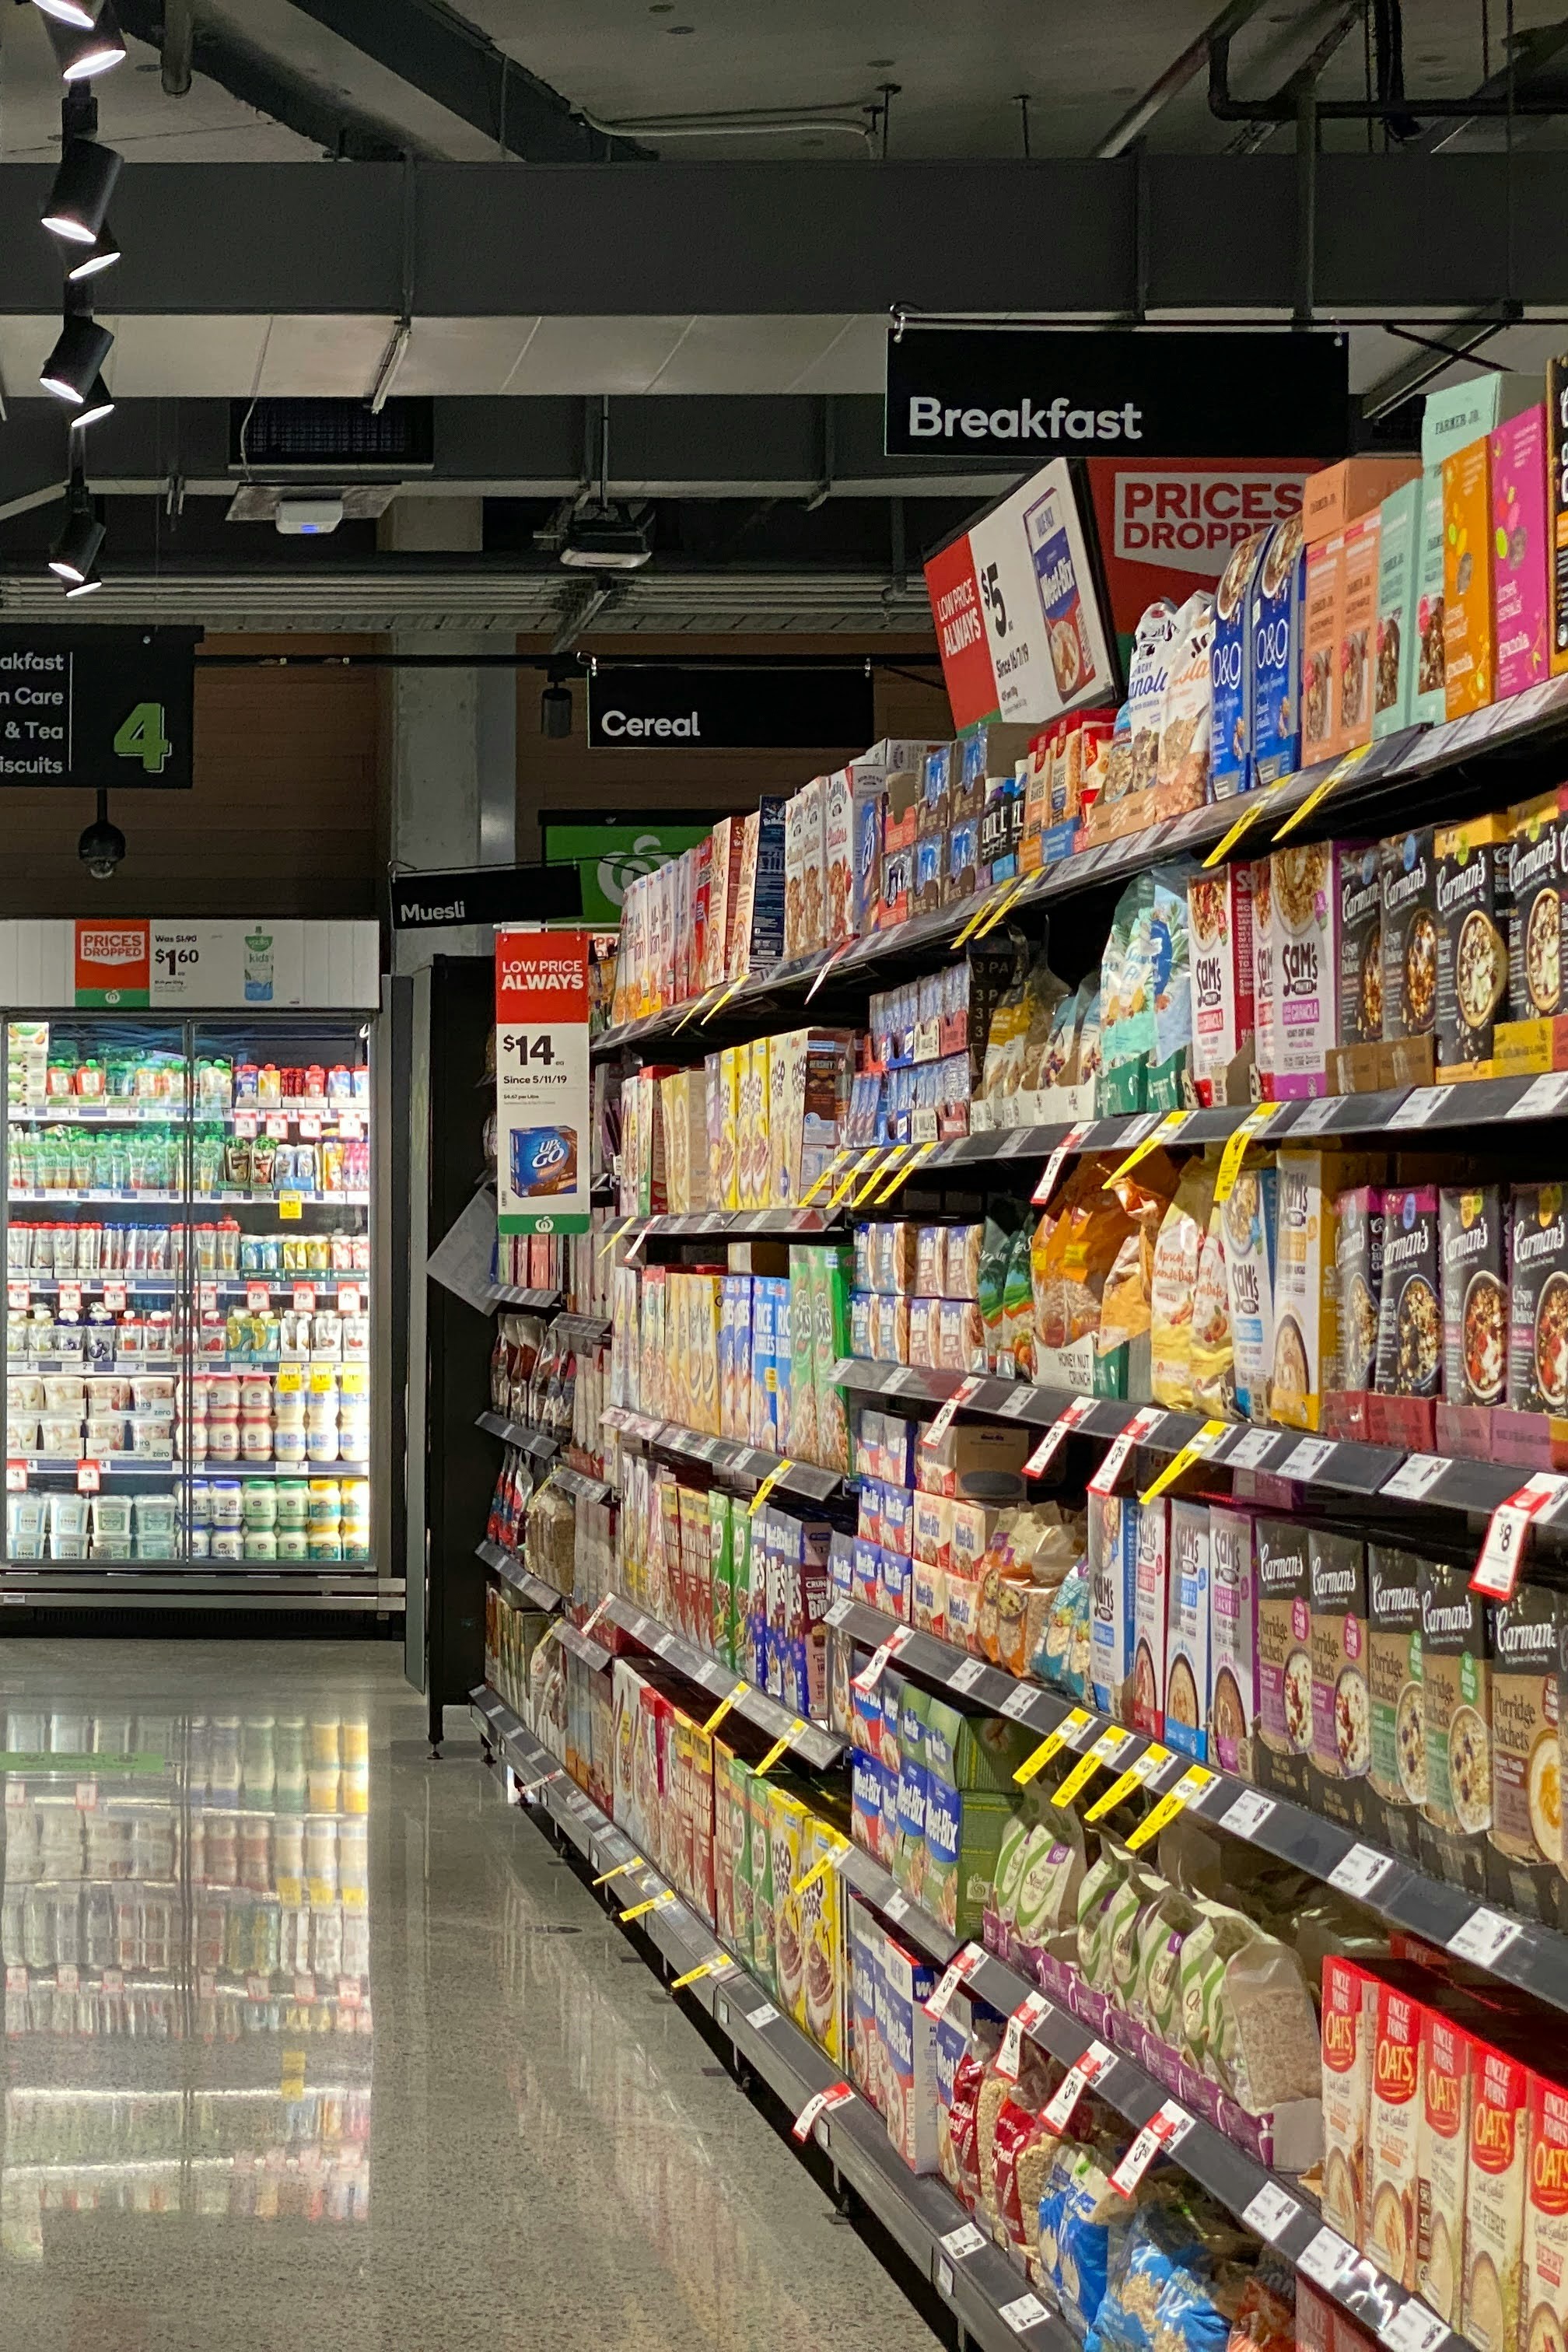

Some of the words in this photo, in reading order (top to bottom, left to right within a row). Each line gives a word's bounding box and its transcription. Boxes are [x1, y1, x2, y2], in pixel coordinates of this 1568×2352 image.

[908, 396, 1143, 439] Breakfast
[1124, 482, 1304, 520] PRICES
[1124, 522, 1272, 549] DROPP
[937, 593, 954, 622] LOW
[952, 577, 975, 614] PRICE
[981, 562, 1007, 638] $5
[1039, 556, 1076, 611] Weet-Bix
[943, 607, 982, 658] ALWAYS
[0, 652, 64, 670] akfast
[15, 687, 64, 705] Care
[5, 721, 20, 739] &
[25, 722, 64, 740] Tea
[114, 702, 172, 773] 4
[601, 710, 701, 737] Cereal
[0, 756, 63, 774] iscuits
[401, 901, 466, 922] Muesli
[84, 935, 142, 947] PRICES
[84, 947, 142, 957] DROPPED
[501, 974, 584, 990] ALWAYS
[502, 961, 537, 973] LOW
[539, 960, 583, 972] PRICE
[503, 1034, 555, 1066] $14
[503, 1075, 530, 1084] Since
[533, 1075, 567, 1084] 5/11/19
[1443, 1216, 1489, 1265] Carman's
[1514, 1215, 1565, 1264] Carman's
[1076, 1354, 1089, 1369] NUT
[1499, 1523, 1512, 1552] $8
[1260, 1543, 1304, 1583] Carman's
[1311, 1556, 1356, 1596] Carman's
[1422, 1591, 1473, 1634] Carman's
[1493, 1685, 1537, 1730] Porridge
[926, 1796, 958, 1854] Weet-Bix
[1388, 1995, 1412, 2023] UNCLE
[1433, 2021, 1454, 2055] UNCLE
[1485, 2053, 1511, 2088] UNCLE
